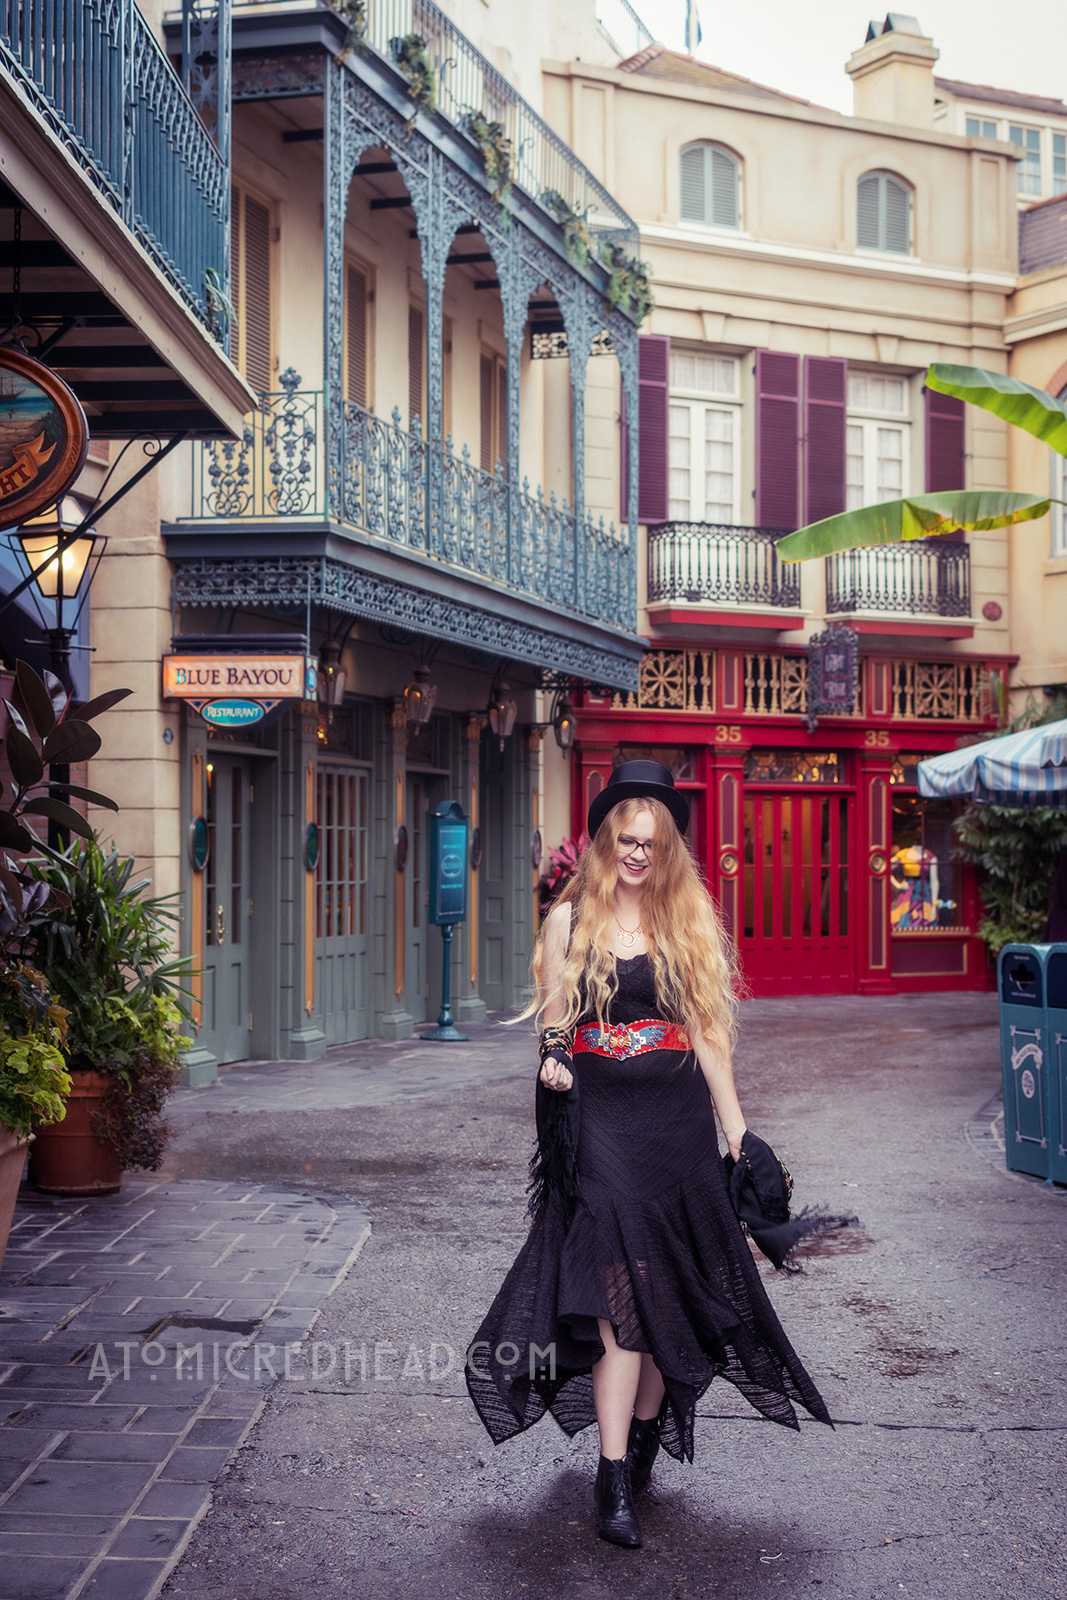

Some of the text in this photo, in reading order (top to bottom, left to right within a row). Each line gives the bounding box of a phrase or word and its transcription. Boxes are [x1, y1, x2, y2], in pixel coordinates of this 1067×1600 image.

[207, 705, 260, 718] RESTAURANT
[715, 725, 742, 743] 35
[864, 730, 890, 747] 35
